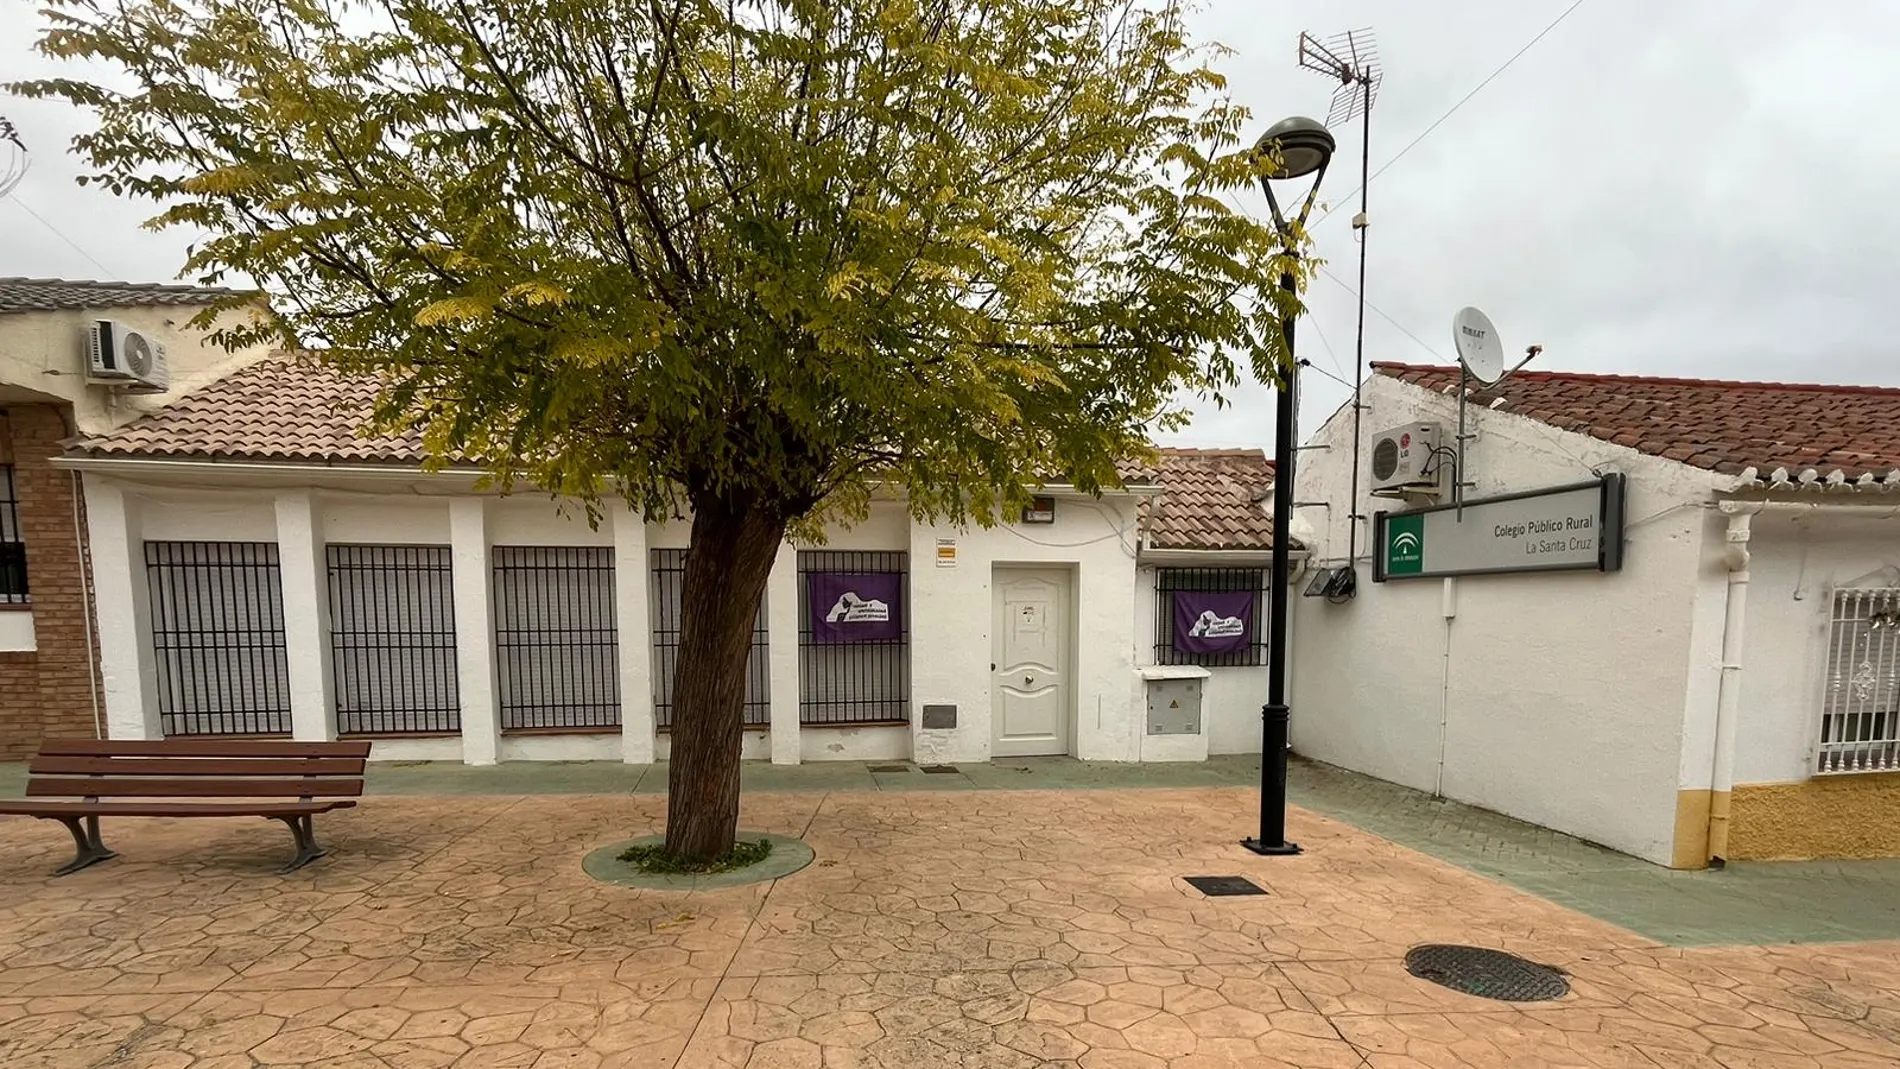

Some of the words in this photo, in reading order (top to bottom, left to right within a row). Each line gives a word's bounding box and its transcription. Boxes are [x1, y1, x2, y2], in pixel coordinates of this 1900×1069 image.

[1400, 449, 1409, 458] LG
[1494, 524, 1525, 538] Colegio
[1528, 518, 1562, 534] Público
[1566, 514, 1592, 530] Rural
[1526, 542, 1537, 554] La
[1539, 539, 1566, 553] Santa
[1569, 537, 1592, 551] Cruz
